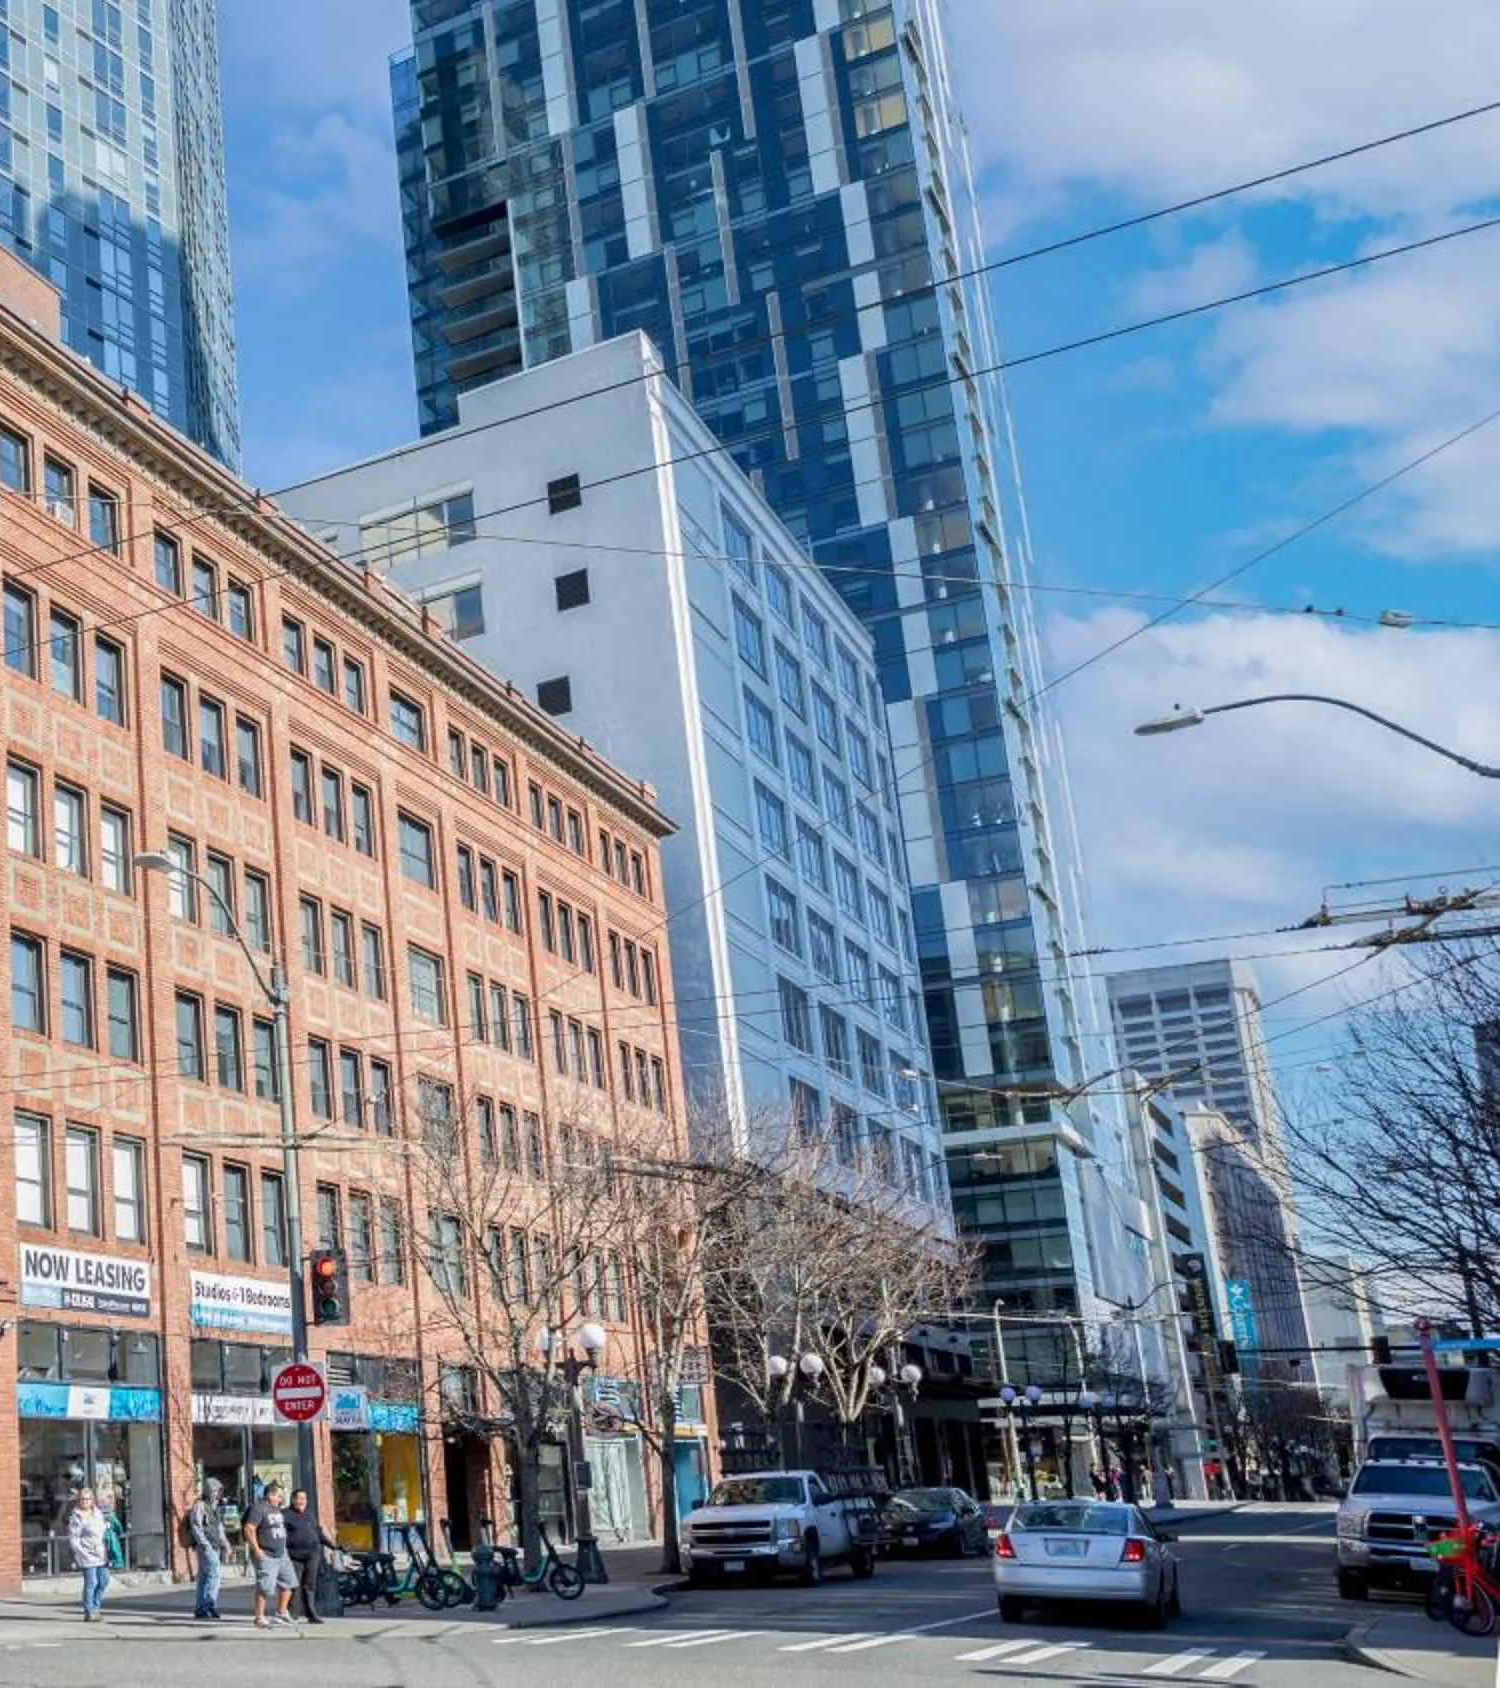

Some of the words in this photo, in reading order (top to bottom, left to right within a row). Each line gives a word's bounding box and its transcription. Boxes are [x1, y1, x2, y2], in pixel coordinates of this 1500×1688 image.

[25, 1249, 69, 1281] NOW
[75, 1258, 146, 1293] LEASING
[194, 1281, 231, 1301] Studios
[245, 1287, 291, 1309] Bedrooms
[279, 1375, 293, 1387] DO
[297, 1374, 316, 1385] NOT
[284, 1400, 315, 1411] ENTER
